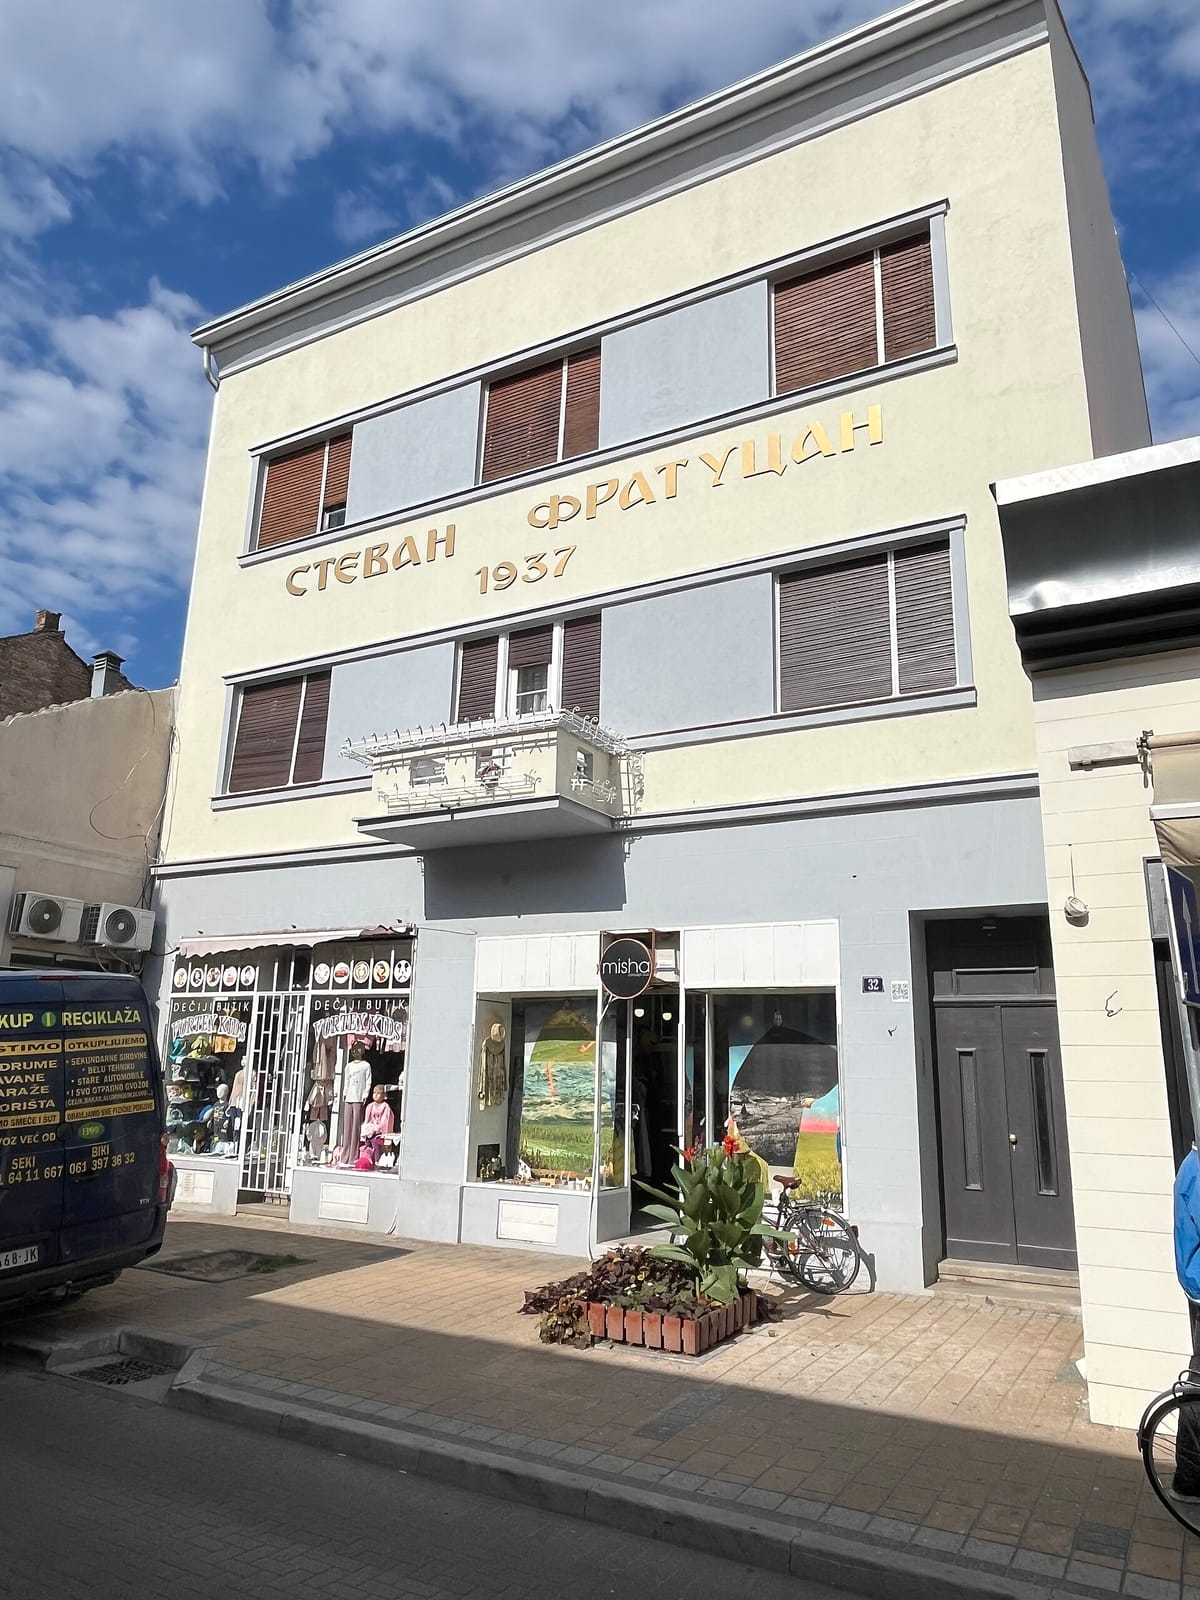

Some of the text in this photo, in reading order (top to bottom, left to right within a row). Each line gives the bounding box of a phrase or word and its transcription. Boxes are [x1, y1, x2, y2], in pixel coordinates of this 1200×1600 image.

[285, 404, 883, 596] СТЕВАН ФРАТУЦАН
[474, 544, 577, 594] 1937
[602, 958, 650, 975] misha
[216, 1001, 249, 1012] BUTIK
[366, 999, 405, 1011] BUTIK
[62, 1006, 141, 1026] RECIKLAŽA
[368, 1013, 402, 1042] KIDS
[68, 1037, 145, 1050] OTKUPLJUJEMO
[71, 1054, 118, 1066] SEKUNDARNE
[42, 1132, 56, 1142] OD
[91, 1144, 110, 1158] BIKI
[12, 1155, 36, 1170] SEKI
[69, 1161, 87, 1175] 061
[91, 1157, 109, 1171] 397
[125, 1152, 135, 1164] 32
[43, 1165, 63, 1179] 667
[0, 1248, 37, 1267] 68-JK
